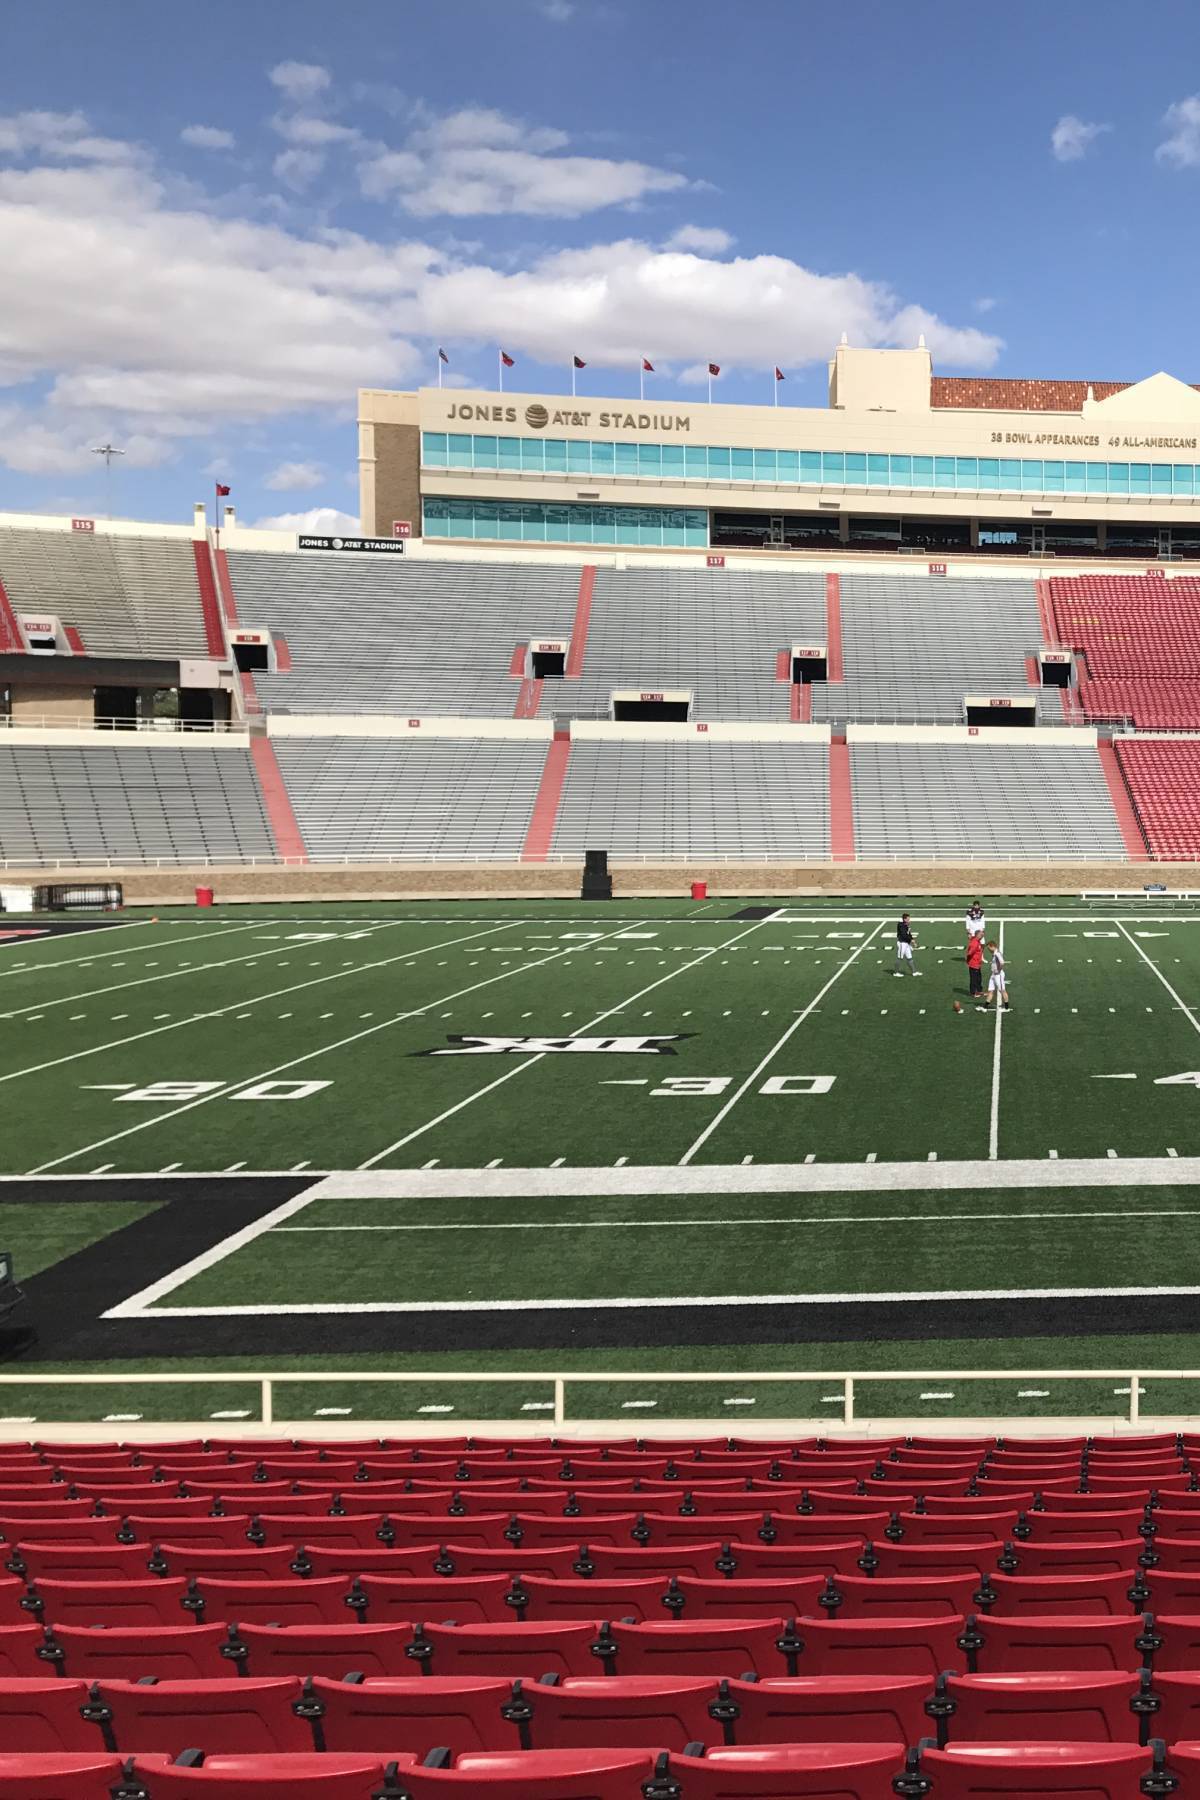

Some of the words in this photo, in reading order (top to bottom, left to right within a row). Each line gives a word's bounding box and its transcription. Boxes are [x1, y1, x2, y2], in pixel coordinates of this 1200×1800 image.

[447, 403, 516, 422] JONES
[552, 410, 591, 427] AT&T
[599, 412, 691, 431] STADIUM
[1005, 433, 1033, 444] BOWL
[1034, 434, 1100, 446] APPEARANCES
[1122, 437, 1197, 449] ALL-AMERICANS
[74, 521, 92, 529] 115
[300, 539, 329, 547] JONES
[343, 541, 362, 549] AT&T
[364, 542, 402, 550] STADIUM
[113, 1079, 335, 1102] 20
[649, 1075, 837, 1096] 30
